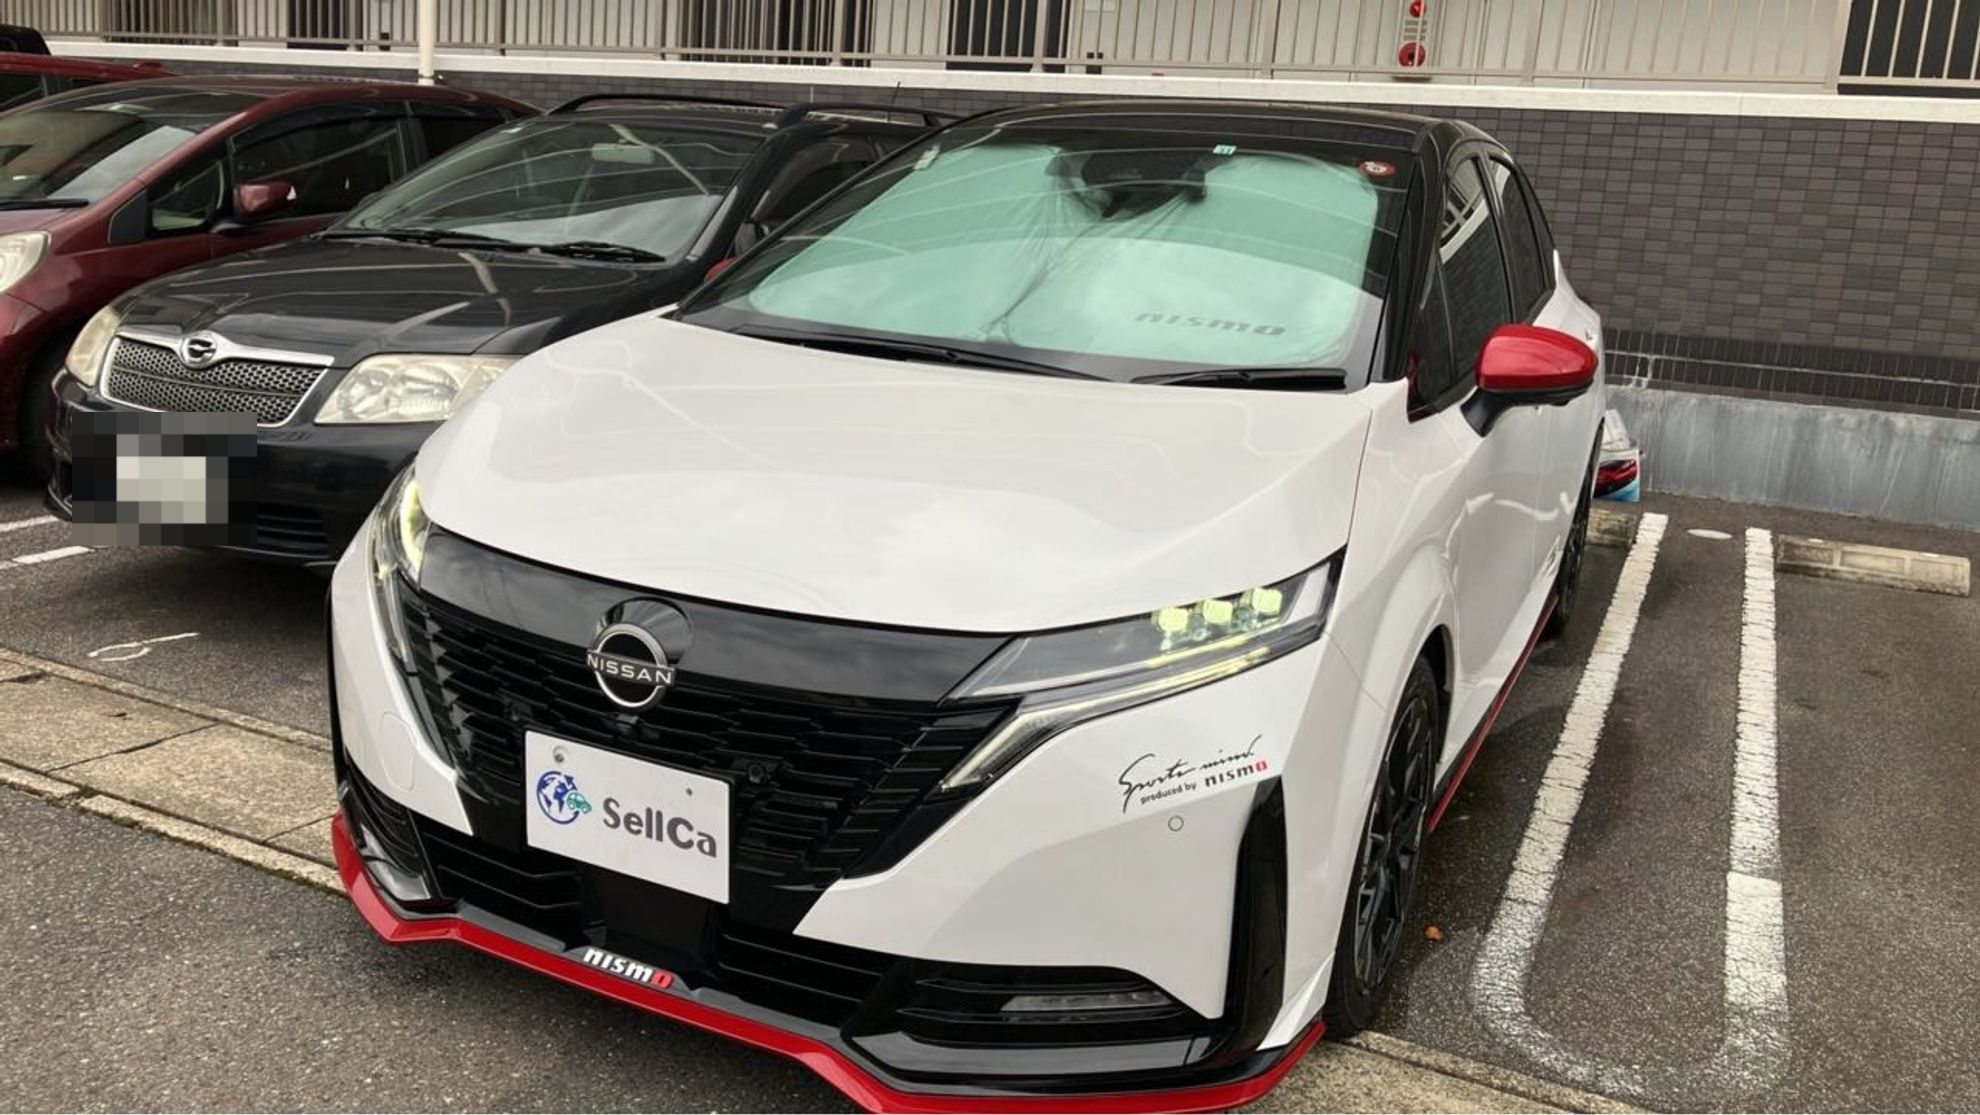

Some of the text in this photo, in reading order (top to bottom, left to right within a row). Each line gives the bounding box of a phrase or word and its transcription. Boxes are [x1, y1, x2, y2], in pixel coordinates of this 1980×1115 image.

[1135, 312, 1286, 336] nismo
[586, 653, 673, 684] NISSAN
[1119, 753, 1196, 813] Sports
[1140, 760, 1268, 804] produced by nismo
[603, 797, 717, 858] SellCa
[583, 948, 673, 989] nismo
